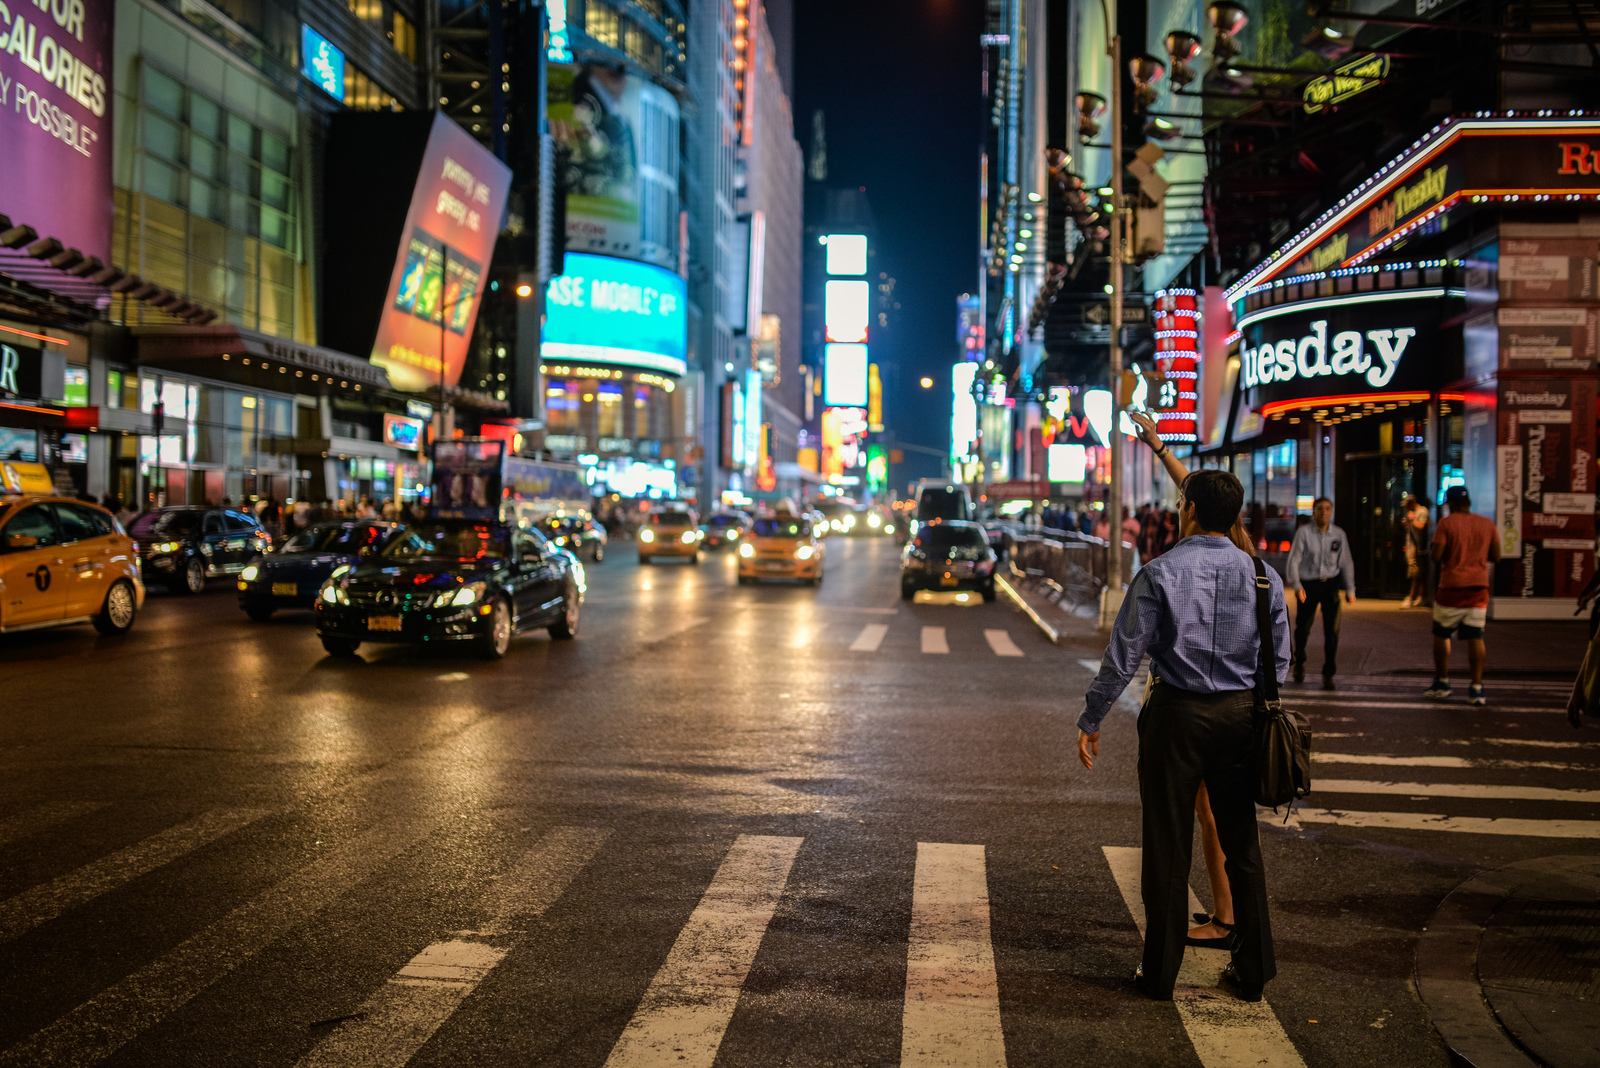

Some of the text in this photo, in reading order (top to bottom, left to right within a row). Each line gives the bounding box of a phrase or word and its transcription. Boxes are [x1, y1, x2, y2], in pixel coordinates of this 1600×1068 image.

[0, 71, 11, 105] Y
[1504, 390, 1567, 407] Tuesday
[1525, 425, 1545, 502] Tuesday
[1572, 448, 1591, 492] Ruby
[1532, 512, 1569, 529] Ruby
